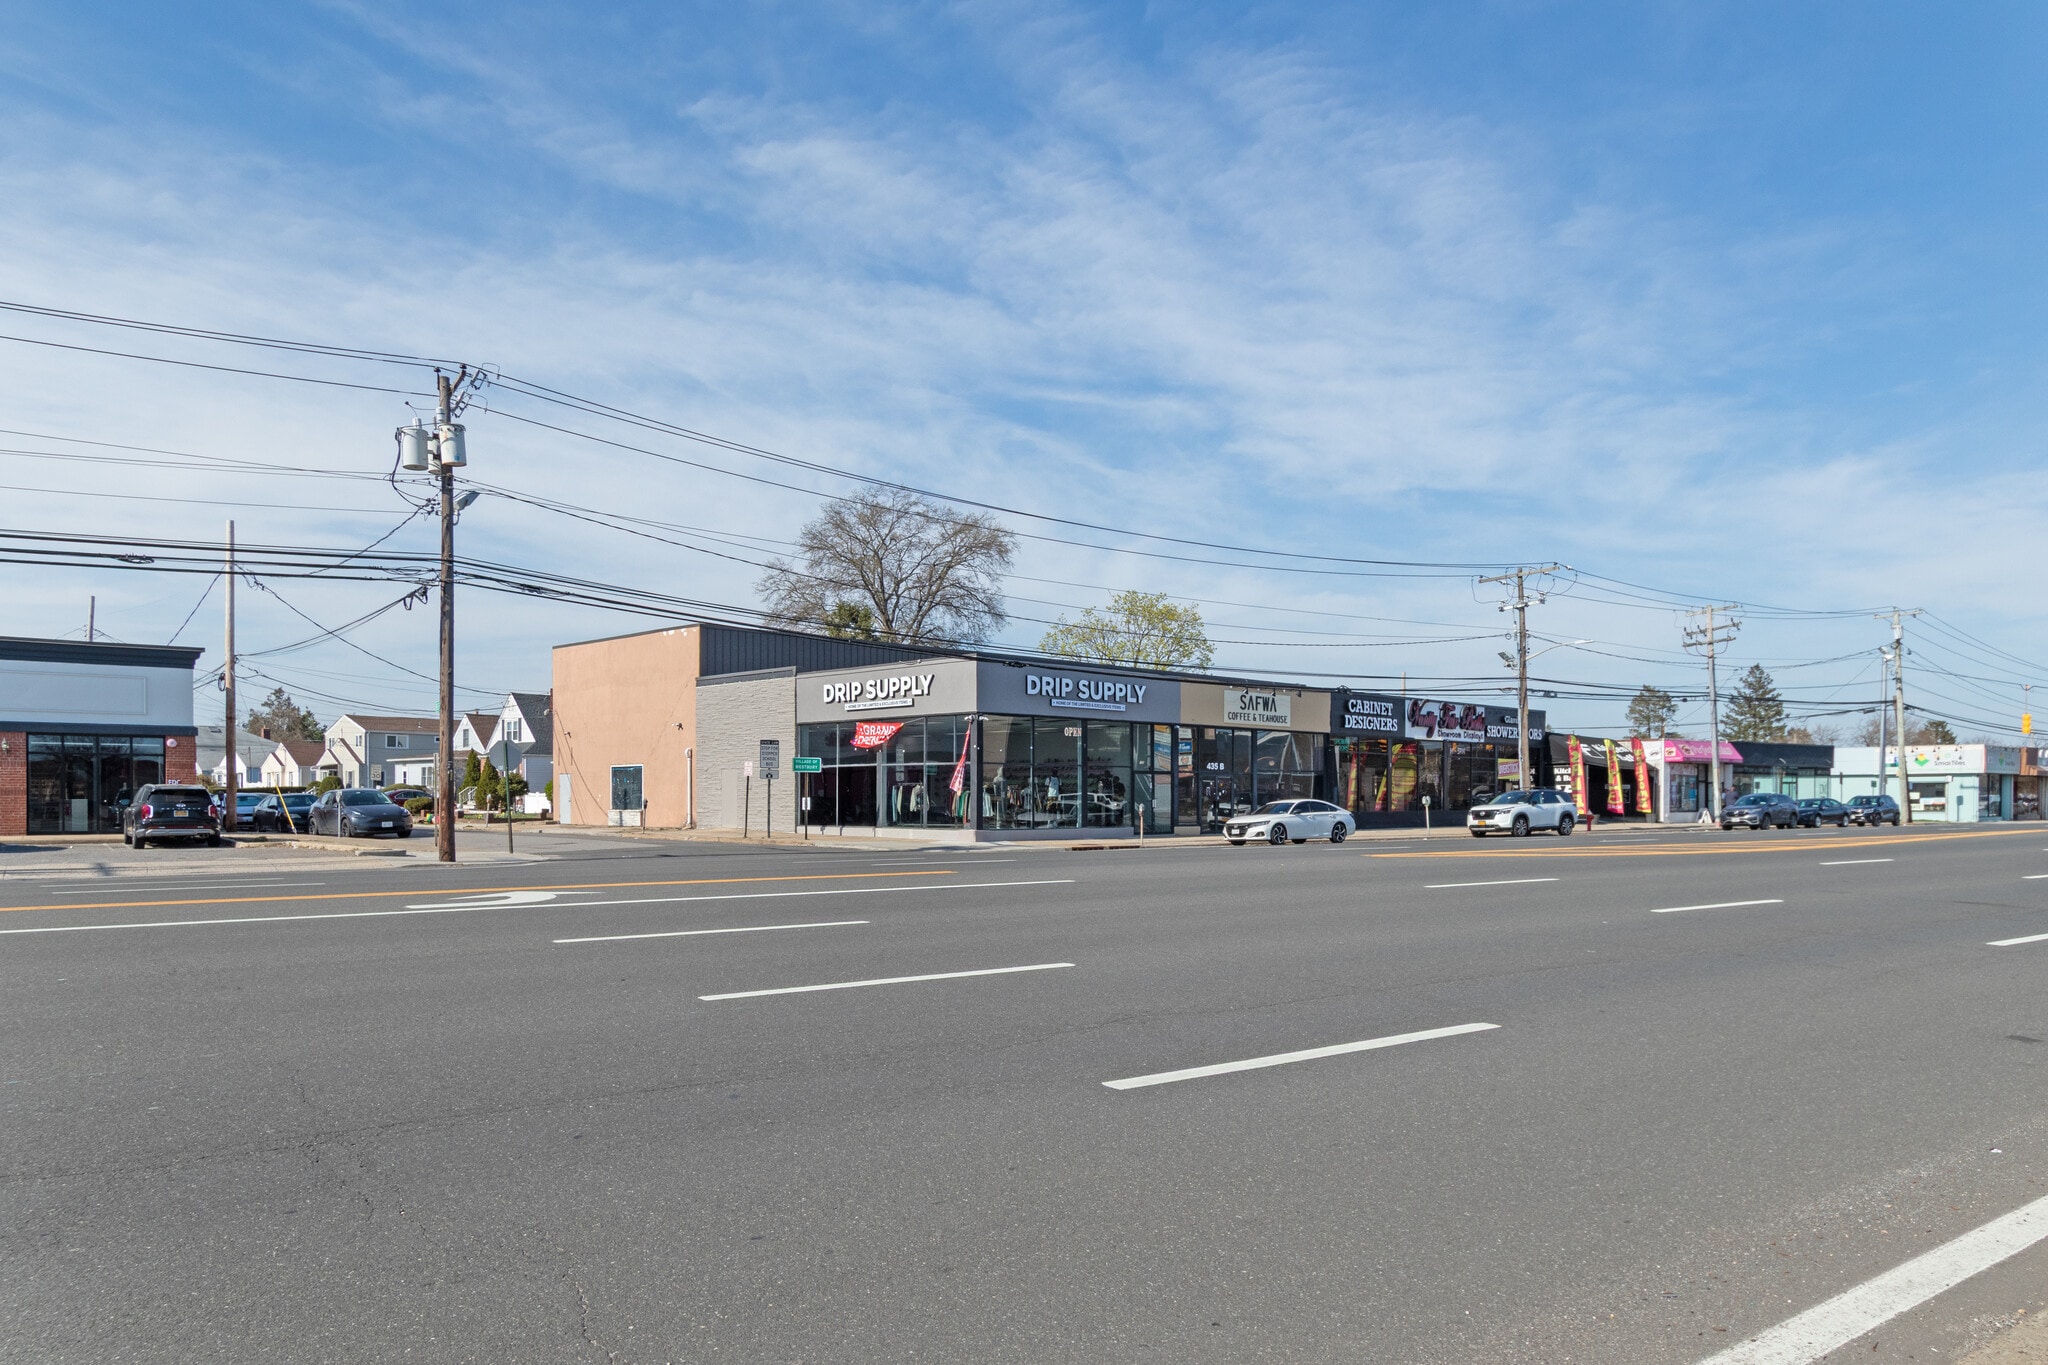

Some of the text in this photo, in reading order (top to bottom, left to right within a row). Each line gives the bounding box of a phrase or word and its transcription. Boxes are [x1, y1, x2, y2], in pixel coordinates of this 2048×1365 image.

[823, 674, 934, 703] DRIP SUPPLY
[1026, 675, 1147, 703] DRIP SUPPLY
[1240, 694, 1277, 713] SAFWA
[1348, 699, 1393, 716] CABINET
[1227, 711, 1251, 722] COFFEE
[1258, 714, 1288, 724] TEAHOUSE
[1344, 714, 1398, 732] DESIGNERS
[1064, 727, 1082, 737] OPEN
[1437, 729, 1461, 739] Showroom
[1486, 725, 1543, 740] SHOWER ORS
[1206, 762, 1225, 770] 435 B
